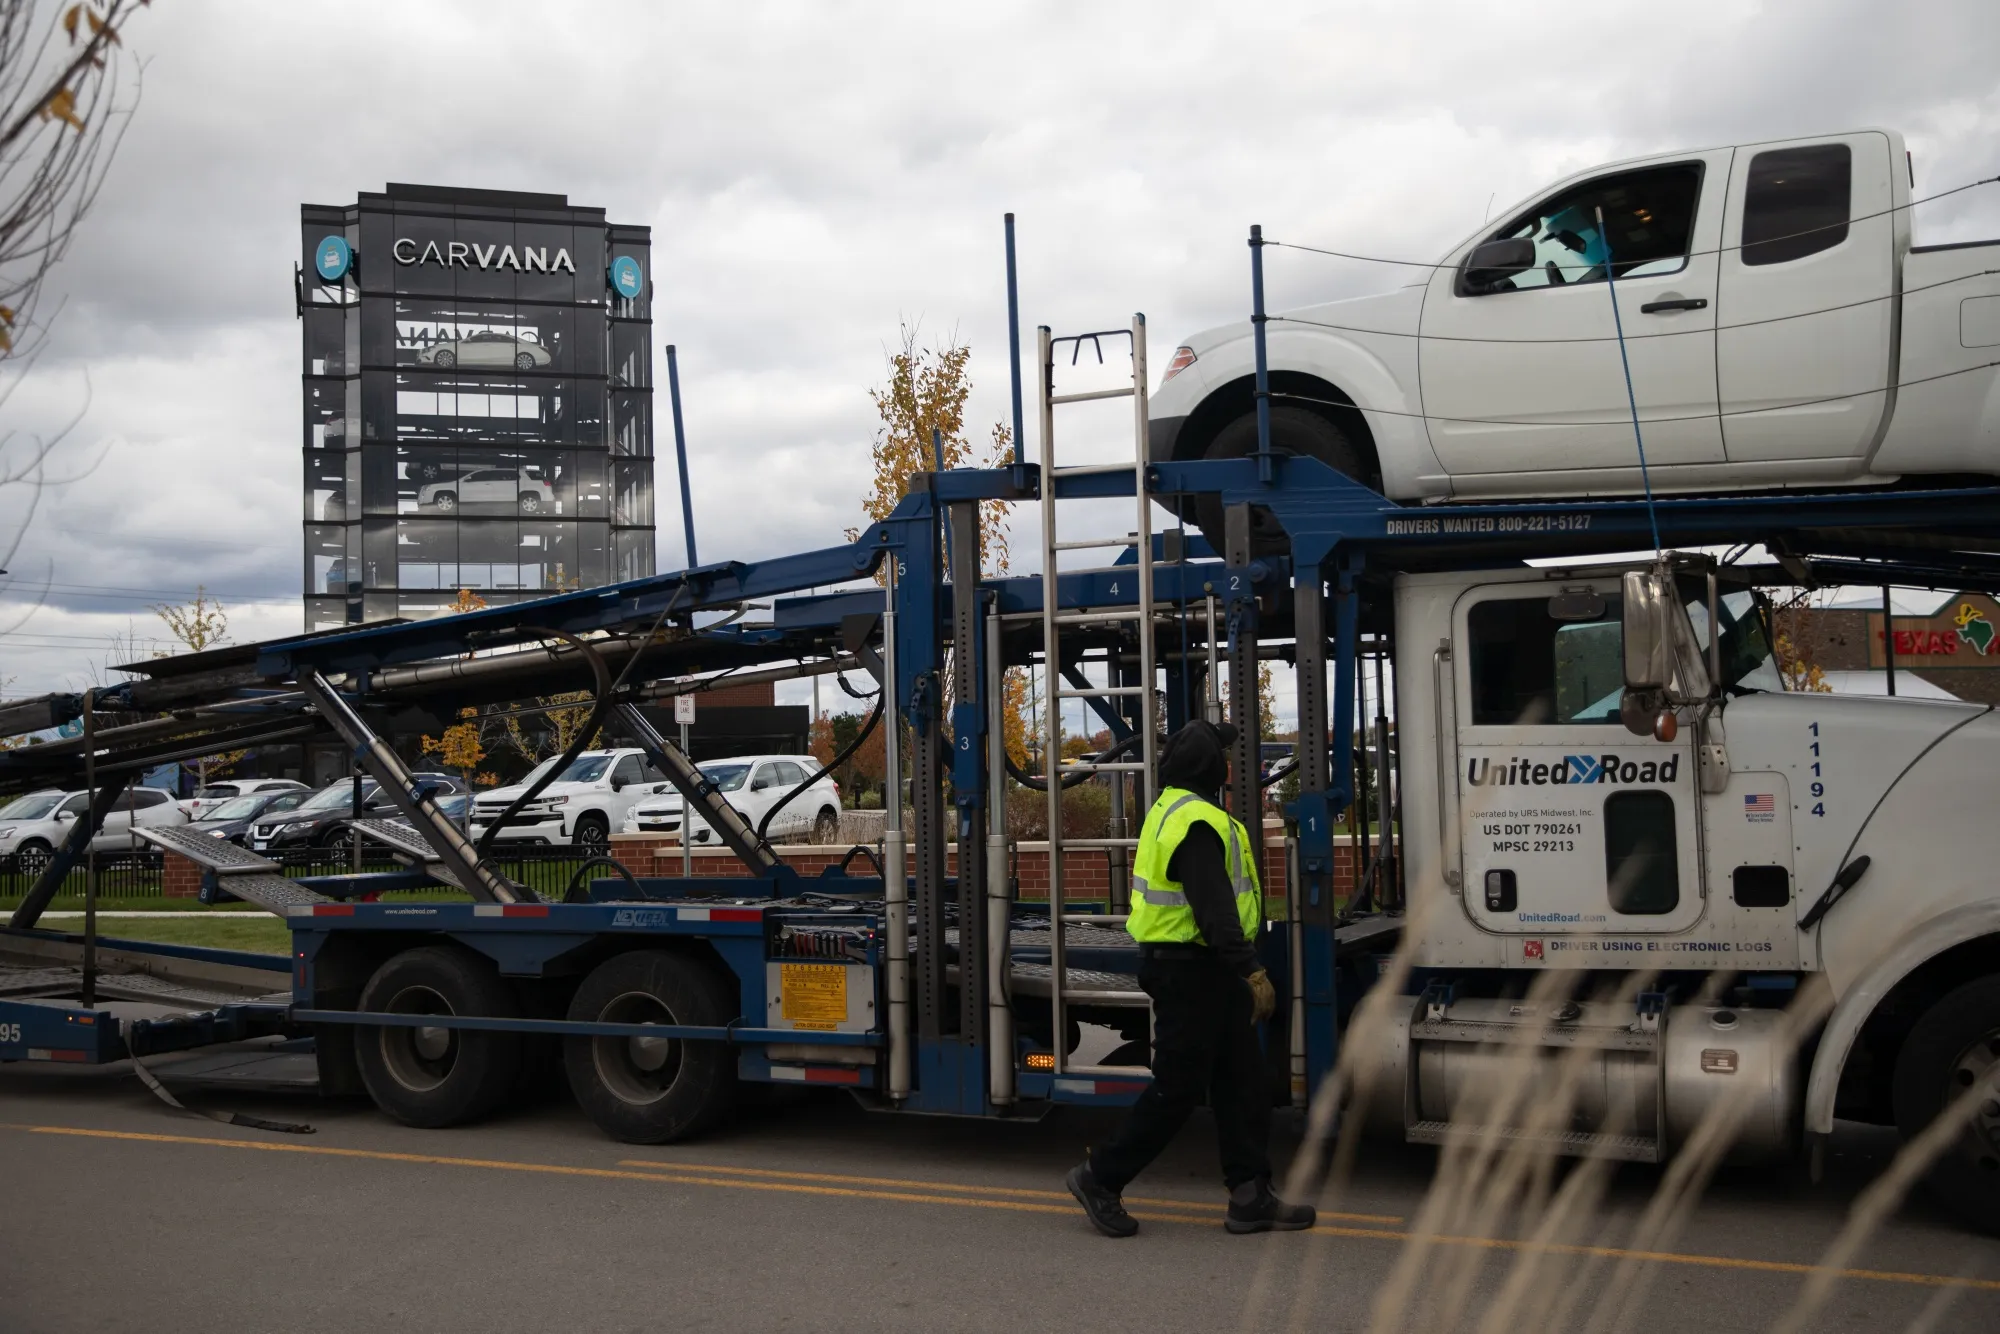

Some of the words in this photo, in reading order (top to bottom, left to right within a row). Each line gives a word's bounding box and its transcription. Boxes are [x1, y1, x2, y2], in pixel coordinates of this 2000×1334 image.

[393, 237, 576, 273] CARVANA
[1386, 518, 1439, 535] DRIVERS
[1443, 517, 1494, 533] WANTED
[1498, 514, 1592, 532] 800-221-5127
[898, 562, 906, 576] 5
[1109, 582, 1119, 596] 4
[1230, 575, 1240, 590] 2
[633, 597, 640, 610] 7
[960, 736, 969, 750] 3
[1467, 755, 1570, 787] United
[1597, 753, 1680, 784] Road
[1469, 809, 1507, 819] Operated
[1508, 809, 1519, 819] by
[1520, 808, 1539, 817] URS
[1579, 808, 1595, 816] Inc.
[1308, 816, 1315, 832] 1
[1483, 824, 1501, 836] US
[1504, 824, 1531, 835] DOT
[1533, 823, 1582, 835] 790261
[1492, 841, 1530, 852] MPSC
[1533, 840, 1574, 852] 29213
[200, 887, 208, 899] 8
[1518, 912, 1606, 922] UnitedRoad.com
[1551, 941, 1599, 951] DRIVER
[1602, 941, 1643, 951] USING
[1647, 942, 1731, 952] ELECTRONIC
[1735, 942, 1773, 952] LOGS
